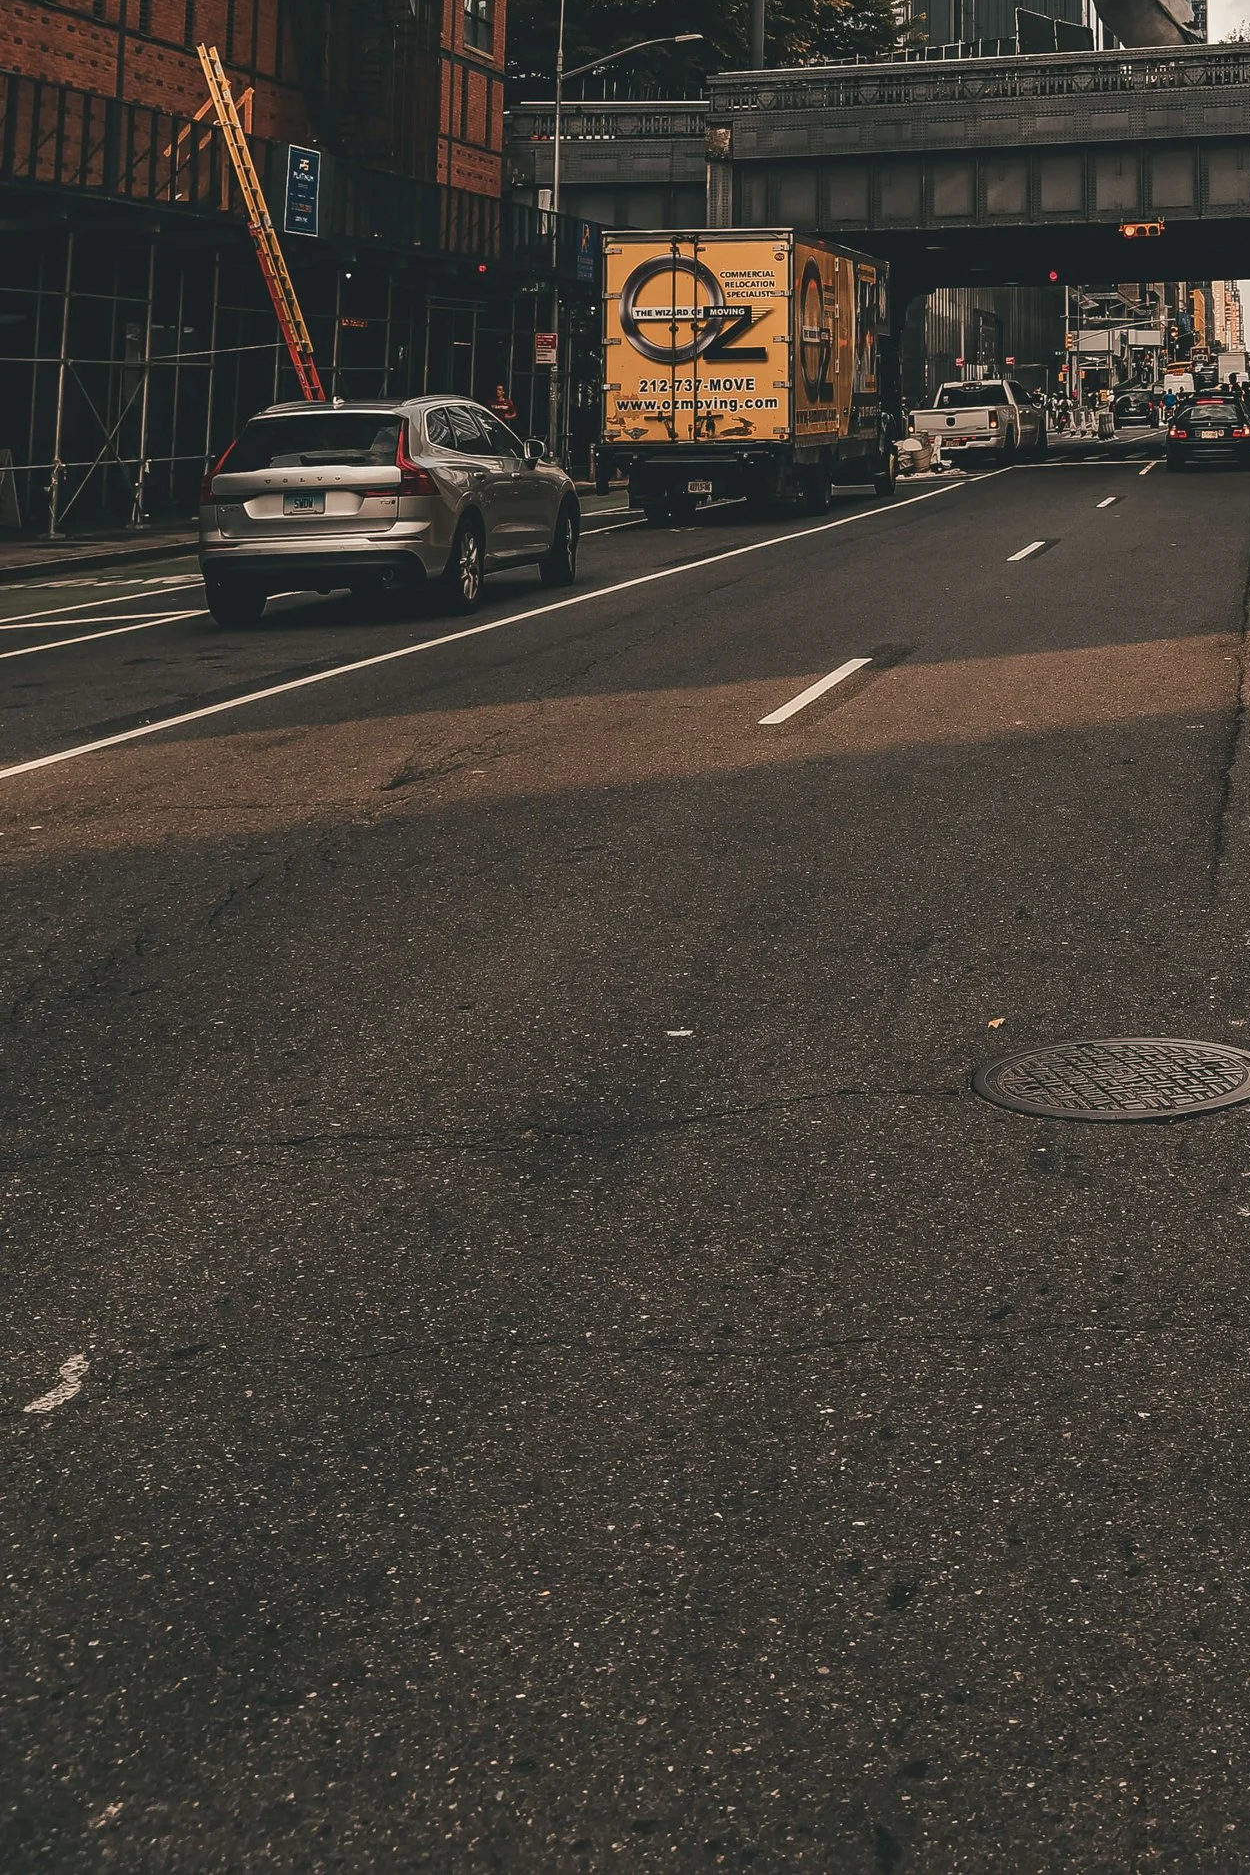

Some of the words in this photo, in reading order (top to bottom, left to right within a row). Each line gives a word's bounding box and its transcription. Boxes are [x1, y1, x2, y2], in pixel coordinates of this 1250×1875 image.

[655, 308, 689, 316] WIZARD
[691, 308, 703, 316] OF
[709, 308, 745, 316] MOVING
[640, 379, 755, 392] 212-737-MOVE
[617, 397, 778, 412] www.ozmoving.com
[264, 476, 341, 485] VOLVO
